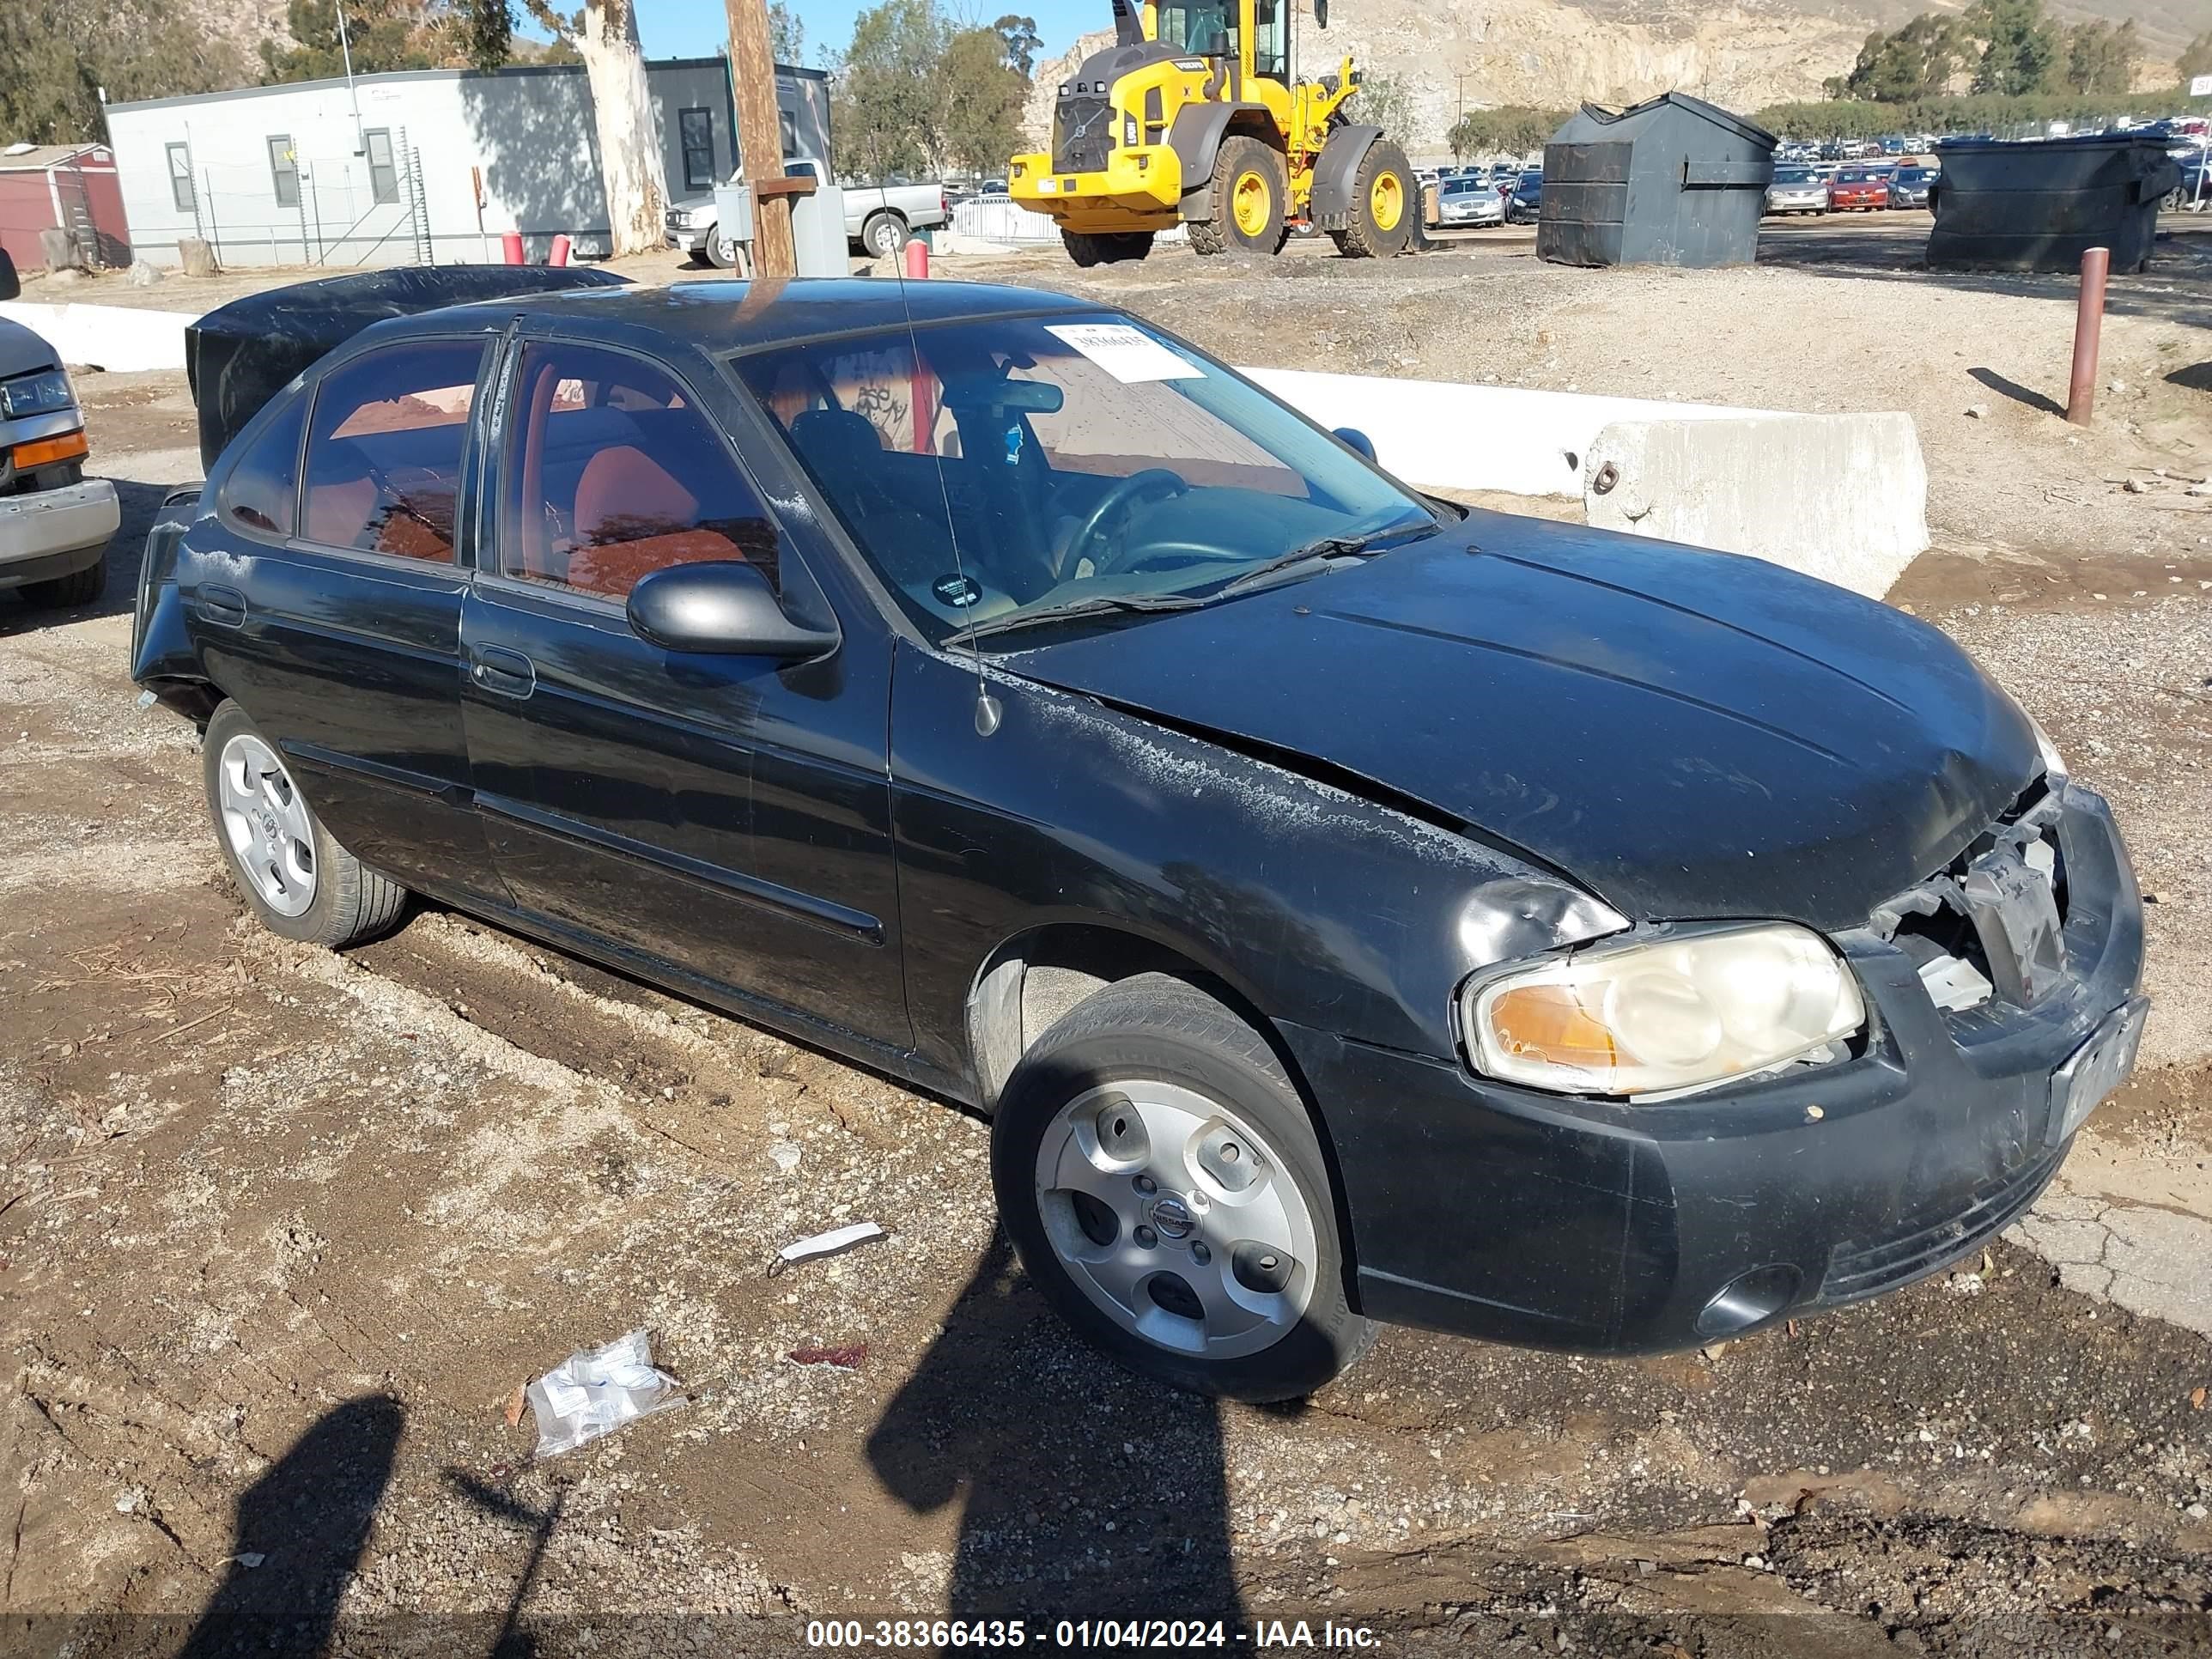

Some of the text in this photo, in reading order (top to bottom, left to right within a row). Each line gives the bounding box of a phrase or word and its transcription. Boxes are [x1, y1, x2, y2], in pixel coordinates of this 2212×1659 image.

[1174, 61, 1205, 70] VOLVO
[1126, 122, 1137, 144] L90H
[1073, 336, 1150, 349] 38366435
